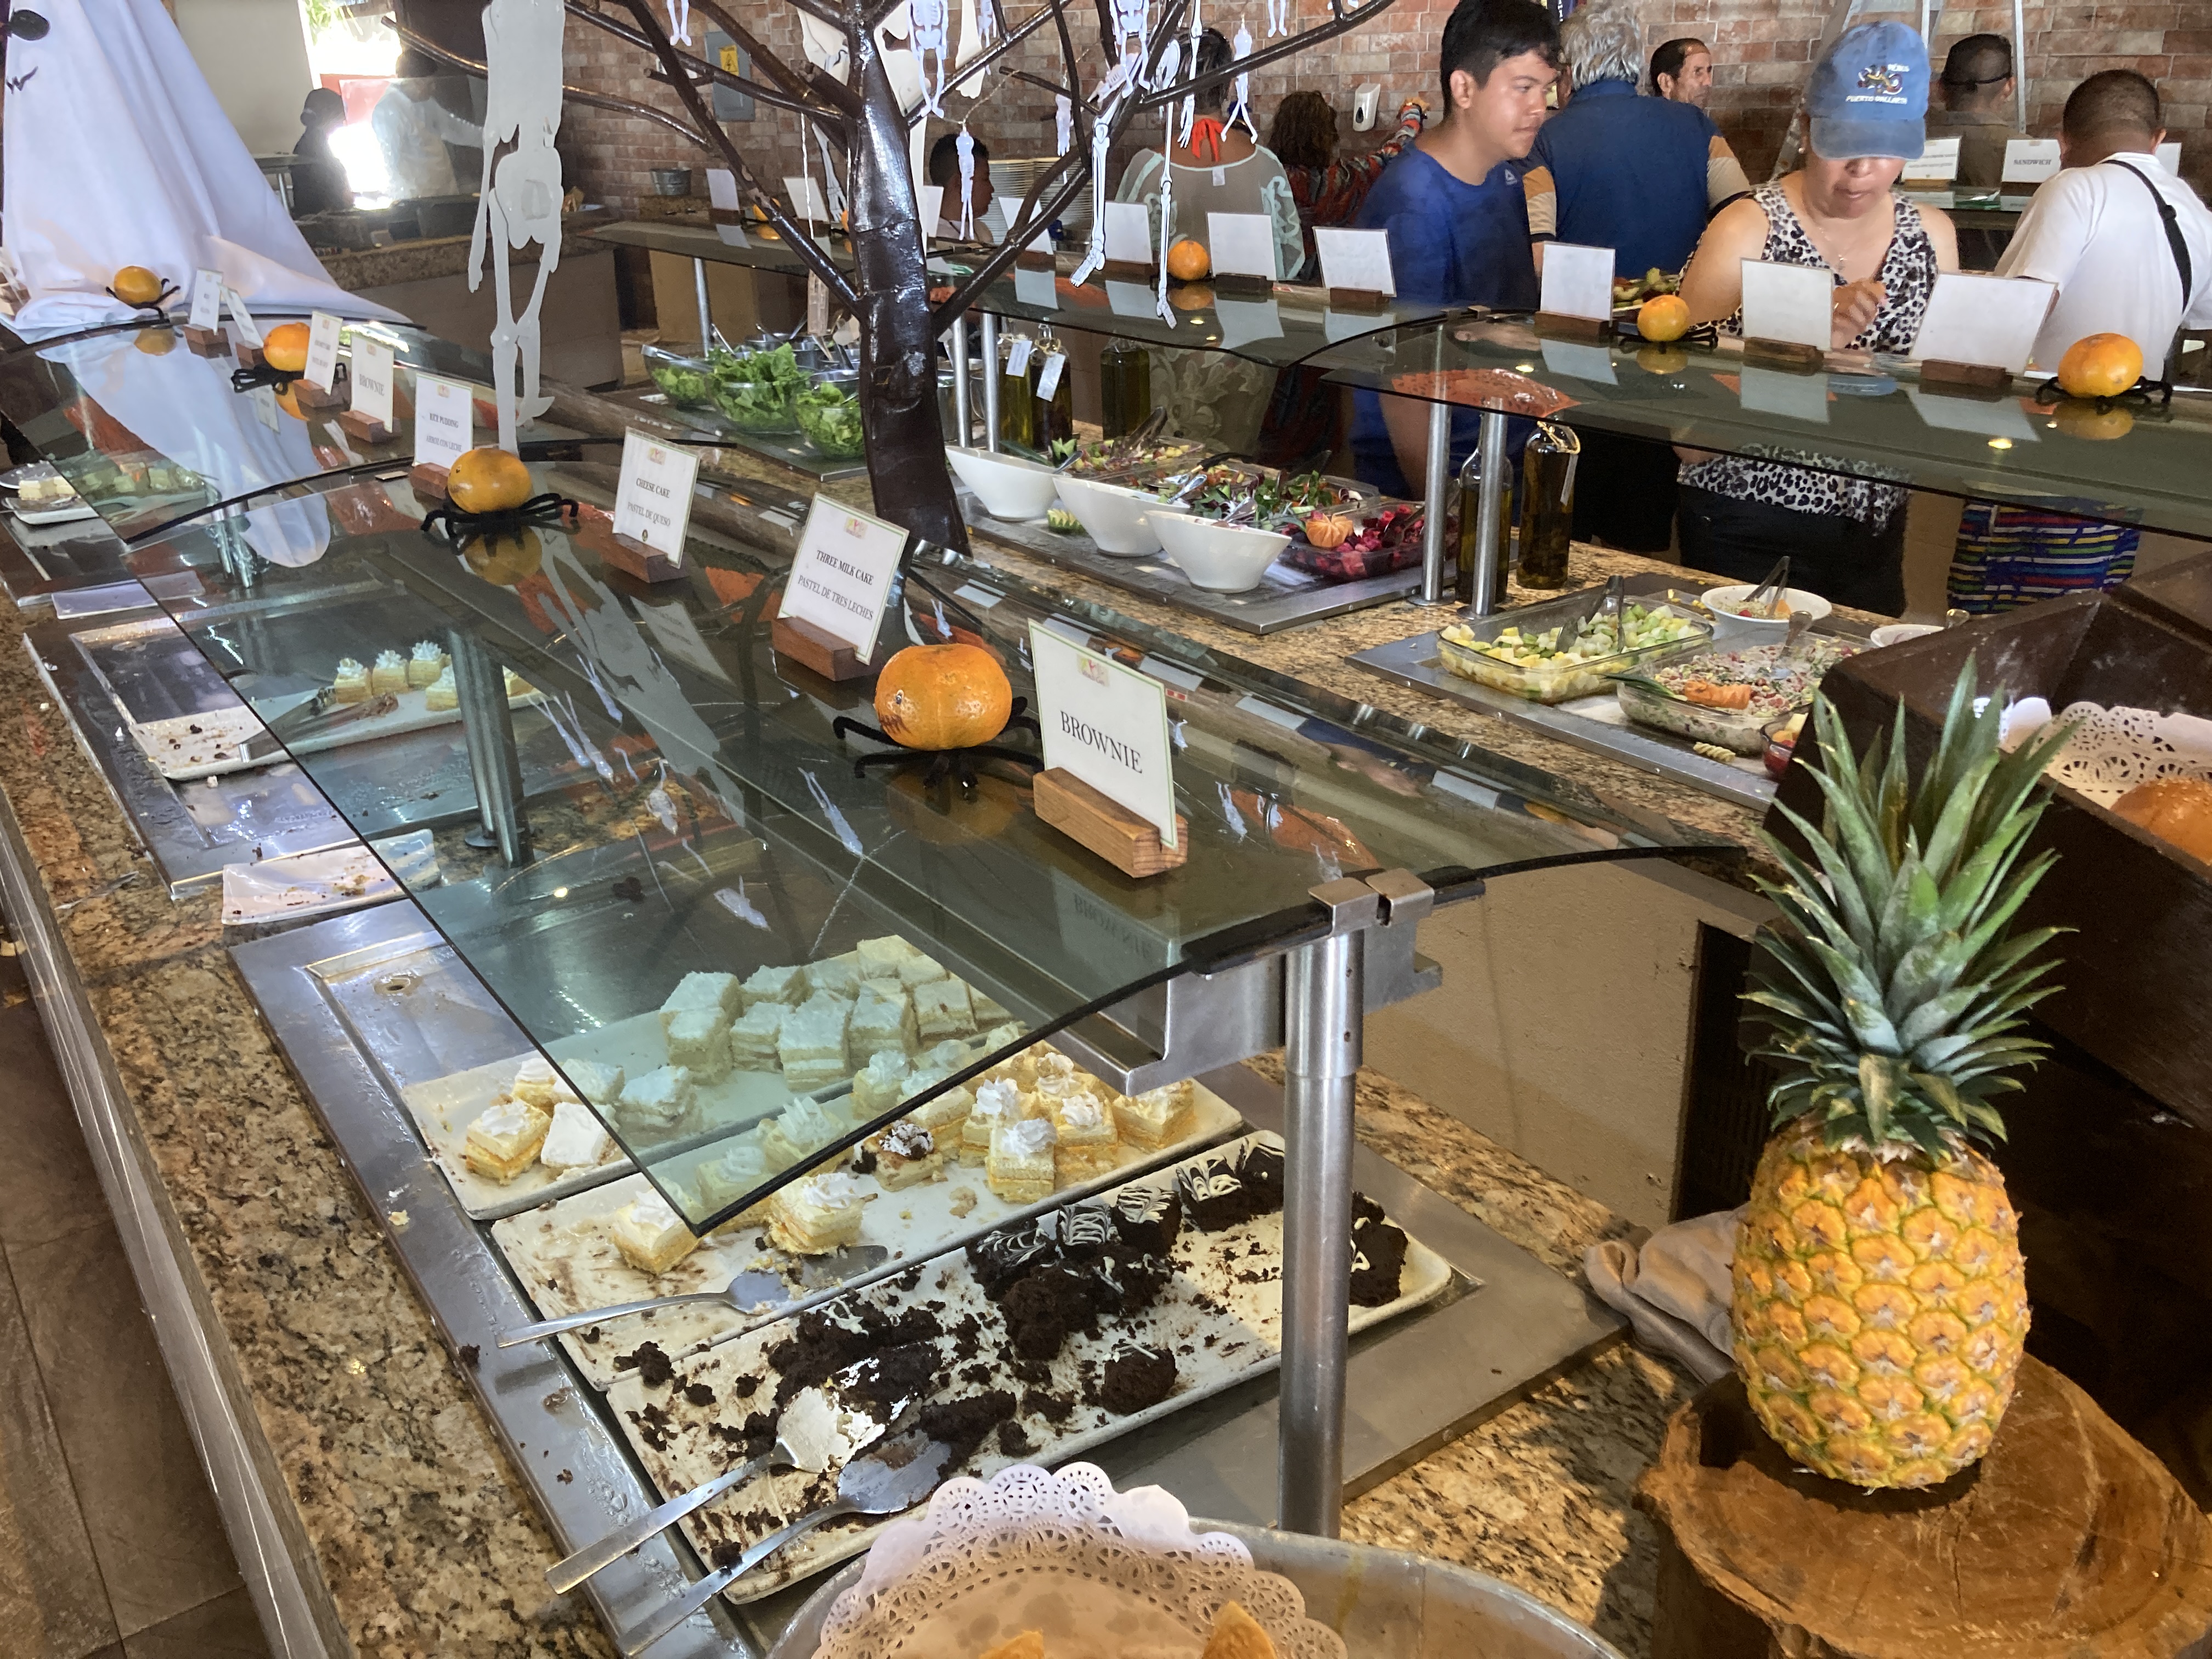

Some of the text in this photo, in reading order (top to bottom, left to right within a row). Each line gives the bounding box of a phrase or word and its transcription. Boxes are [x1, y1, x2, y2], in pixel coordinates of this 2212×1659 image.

[359, 374, 385, 396] BROWNIE
[430, 413, 459, 428] RICE PUDDING
[439, 439, 448, 448] CON
[449, 441, 462, 452] LECHE
[636, 478, 670, 498] CHEESE CAKE
[628, 501, 671, 527] PASTEL DE QUESO
[816, 550, 874, 585] THREE MILK CAKE
[798, 575, 874, 620] PASTEL DE TRES LECHES
[1060, 710, 1143, 774] BROWNIE
